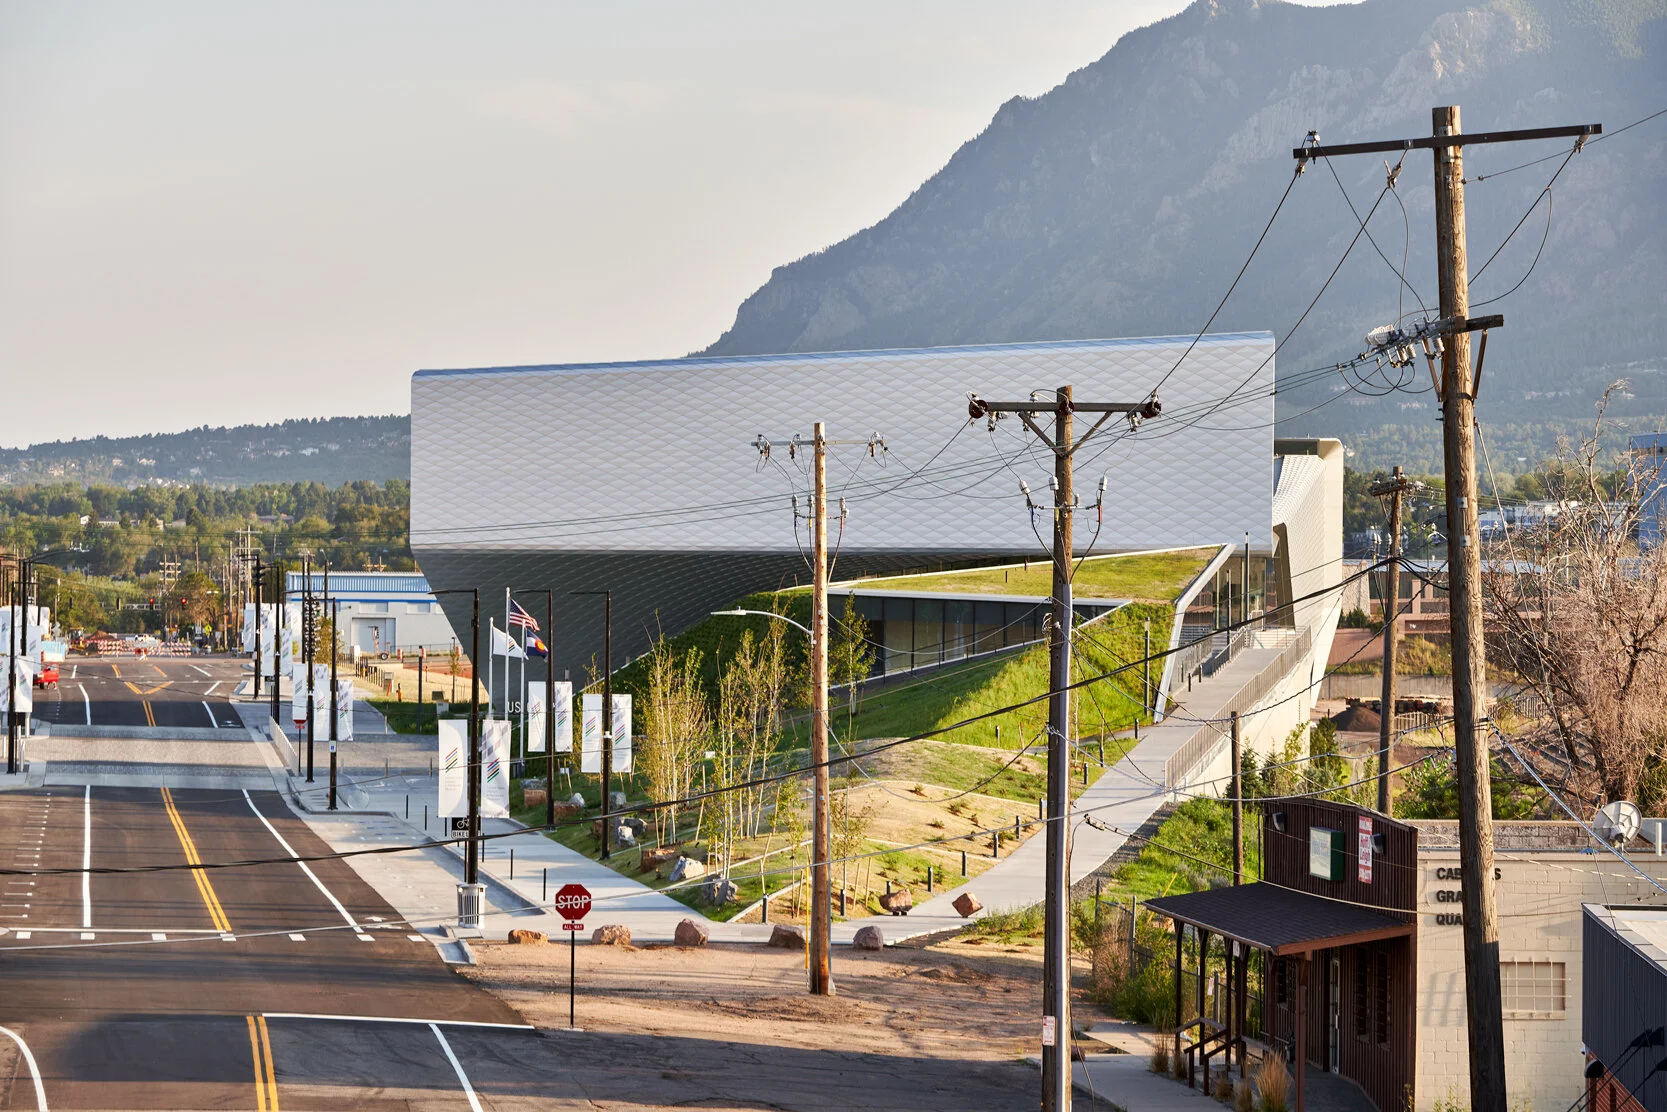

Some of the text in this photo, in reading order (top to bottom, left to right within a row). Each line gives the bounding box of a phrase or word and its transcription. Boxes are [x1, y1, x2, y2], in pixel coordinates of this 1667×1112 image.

[1436, 867, 1502, 881] CABS
[557, 895, 590, 909] STOP
[1436, 912, 1464, 926] QUA
